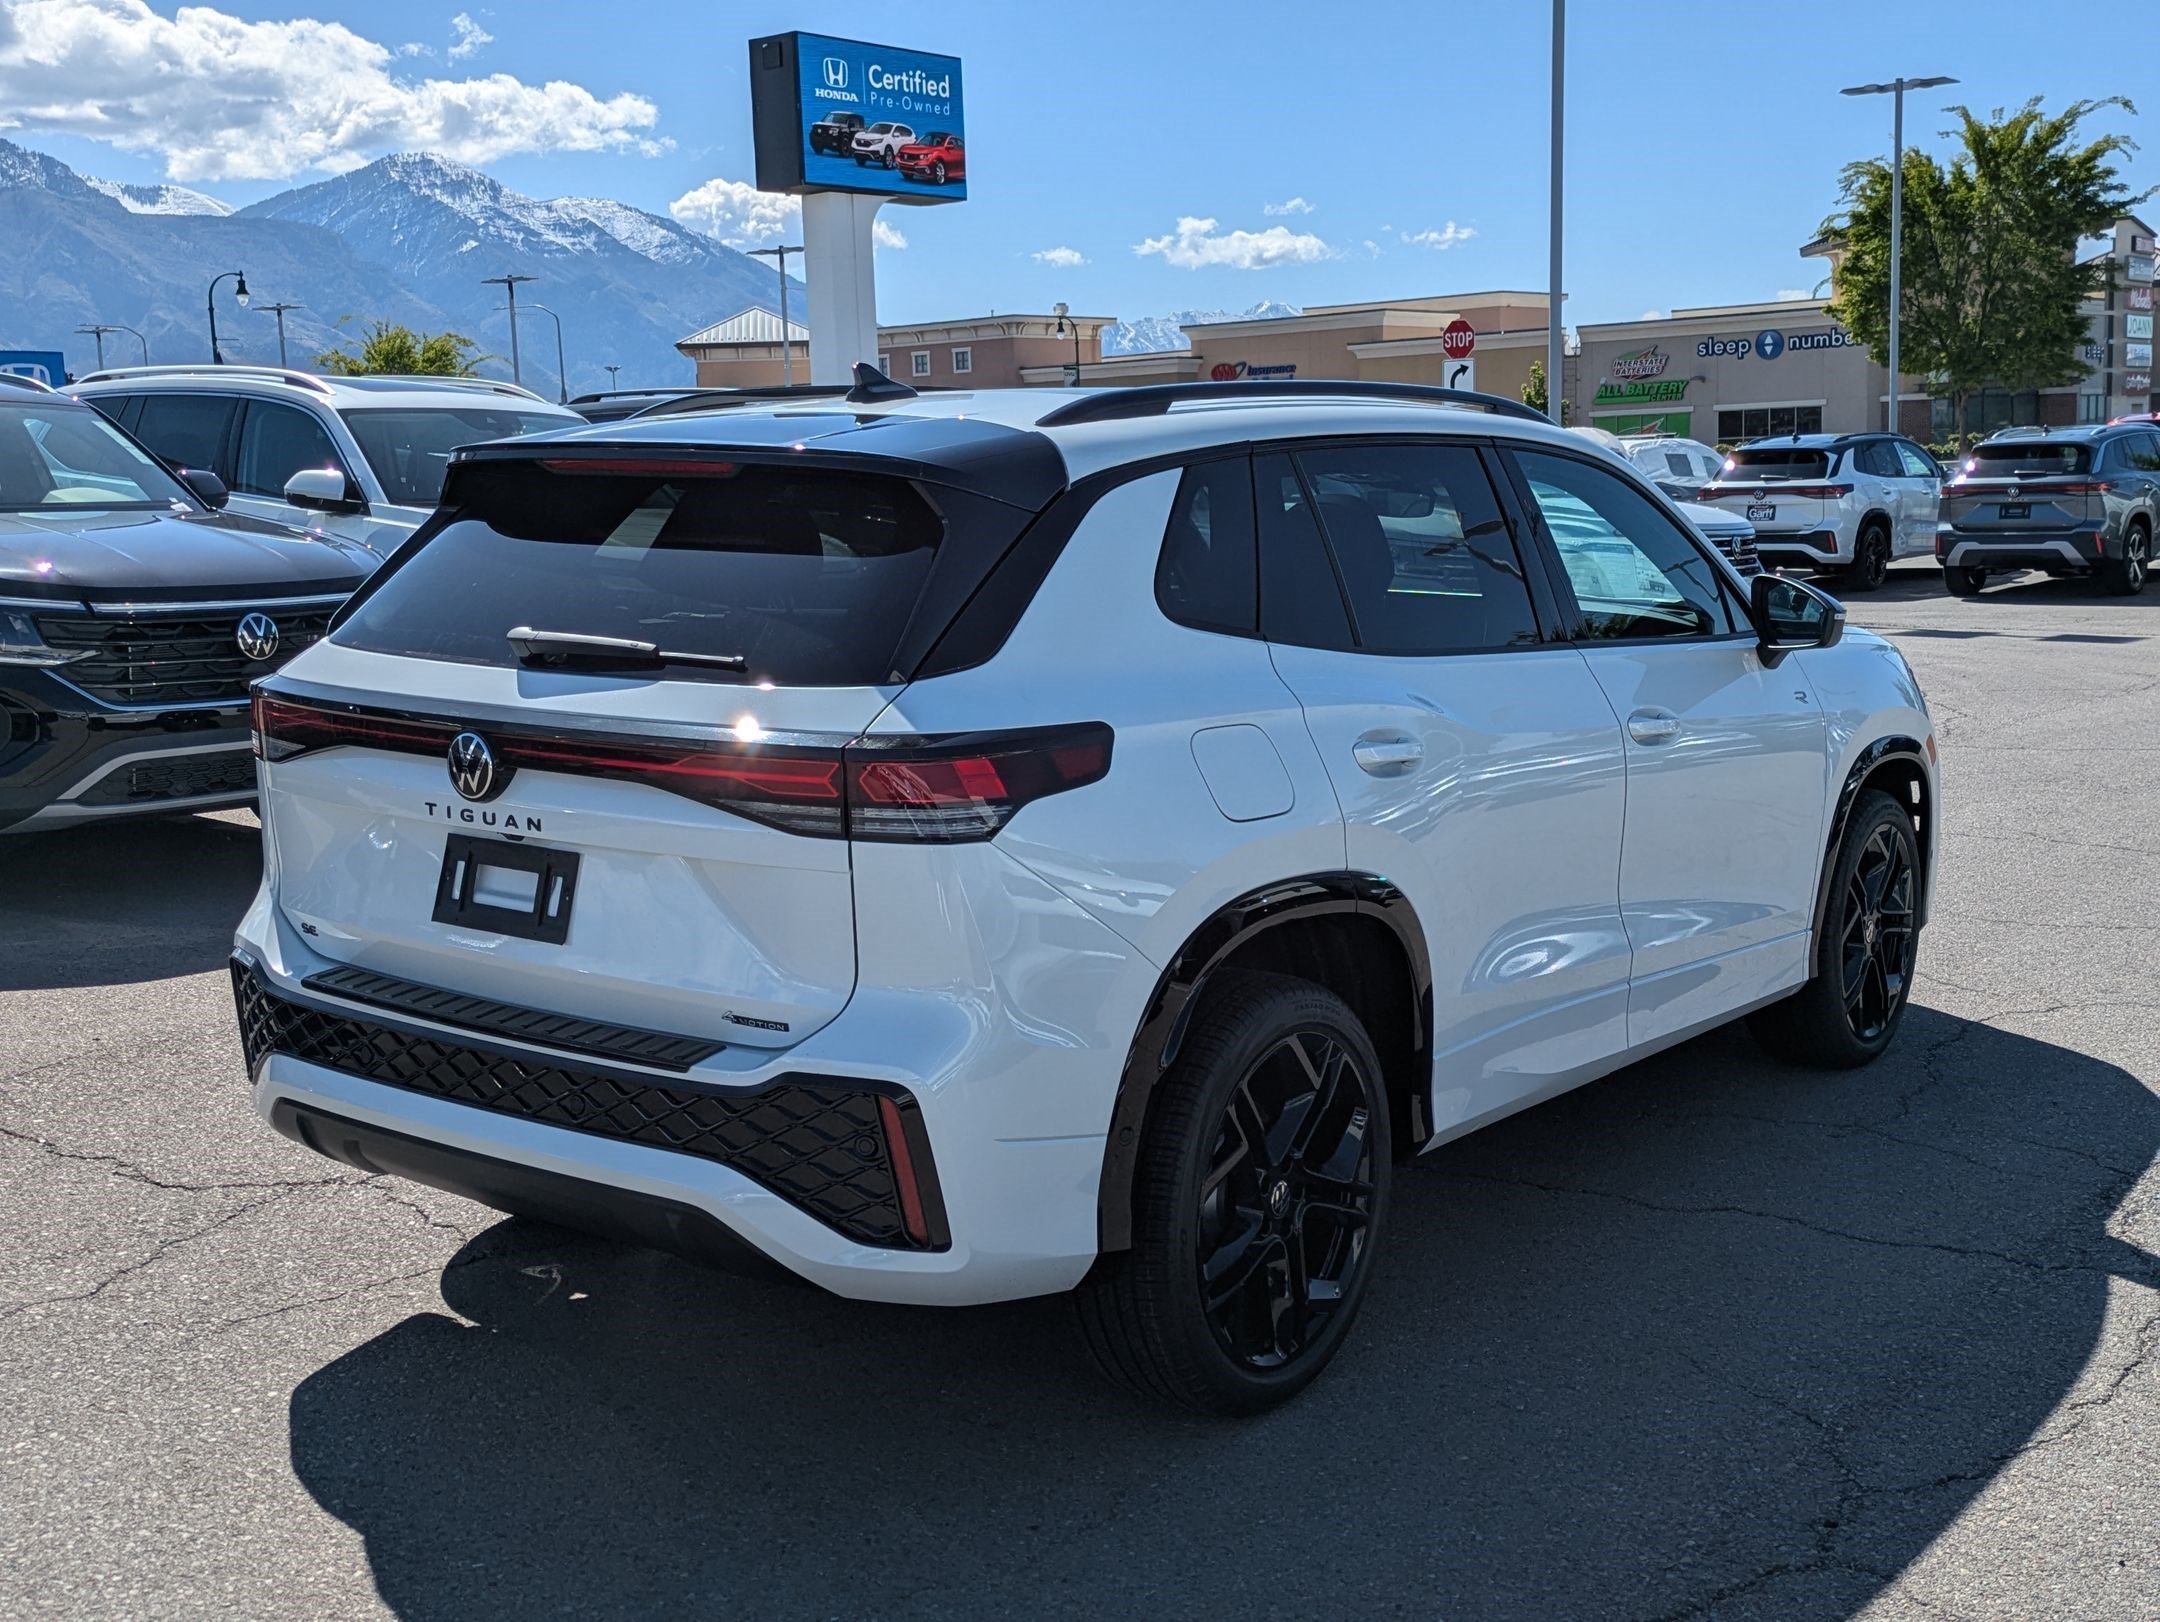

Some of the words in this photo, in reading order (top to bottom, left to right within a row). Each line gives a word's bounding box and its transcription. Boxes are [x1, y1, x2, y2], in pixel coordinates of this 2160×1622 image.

[868, 64, 950, 98] Certified
[815, 88, 859, 102] HONDA
[870, 92, 950, 115] Pre-Owned
[1444, 331, 1473, 348] STOP
[1698, 338, 1750, 358] sleep
[1789, 328, 1862, 350] numbe
[1613, 357, 1665, 368] INTERSTATE
[1247, 365, 1296, 376] Insurance
[1614, 366, 1661, 377] BATTERIES
[1599, 384, 1622, 397] ALL
[1626, 381, 1687, 395] BATTERY
[1650, 393, 1684, 401] CENTER
[1748, 508, 1774, 518] Garff
[424, 802, 543, 832] TIGUAN
[301, 922, 319, 936] SE
[721, 1010, 785, 1031] 4MOTION
